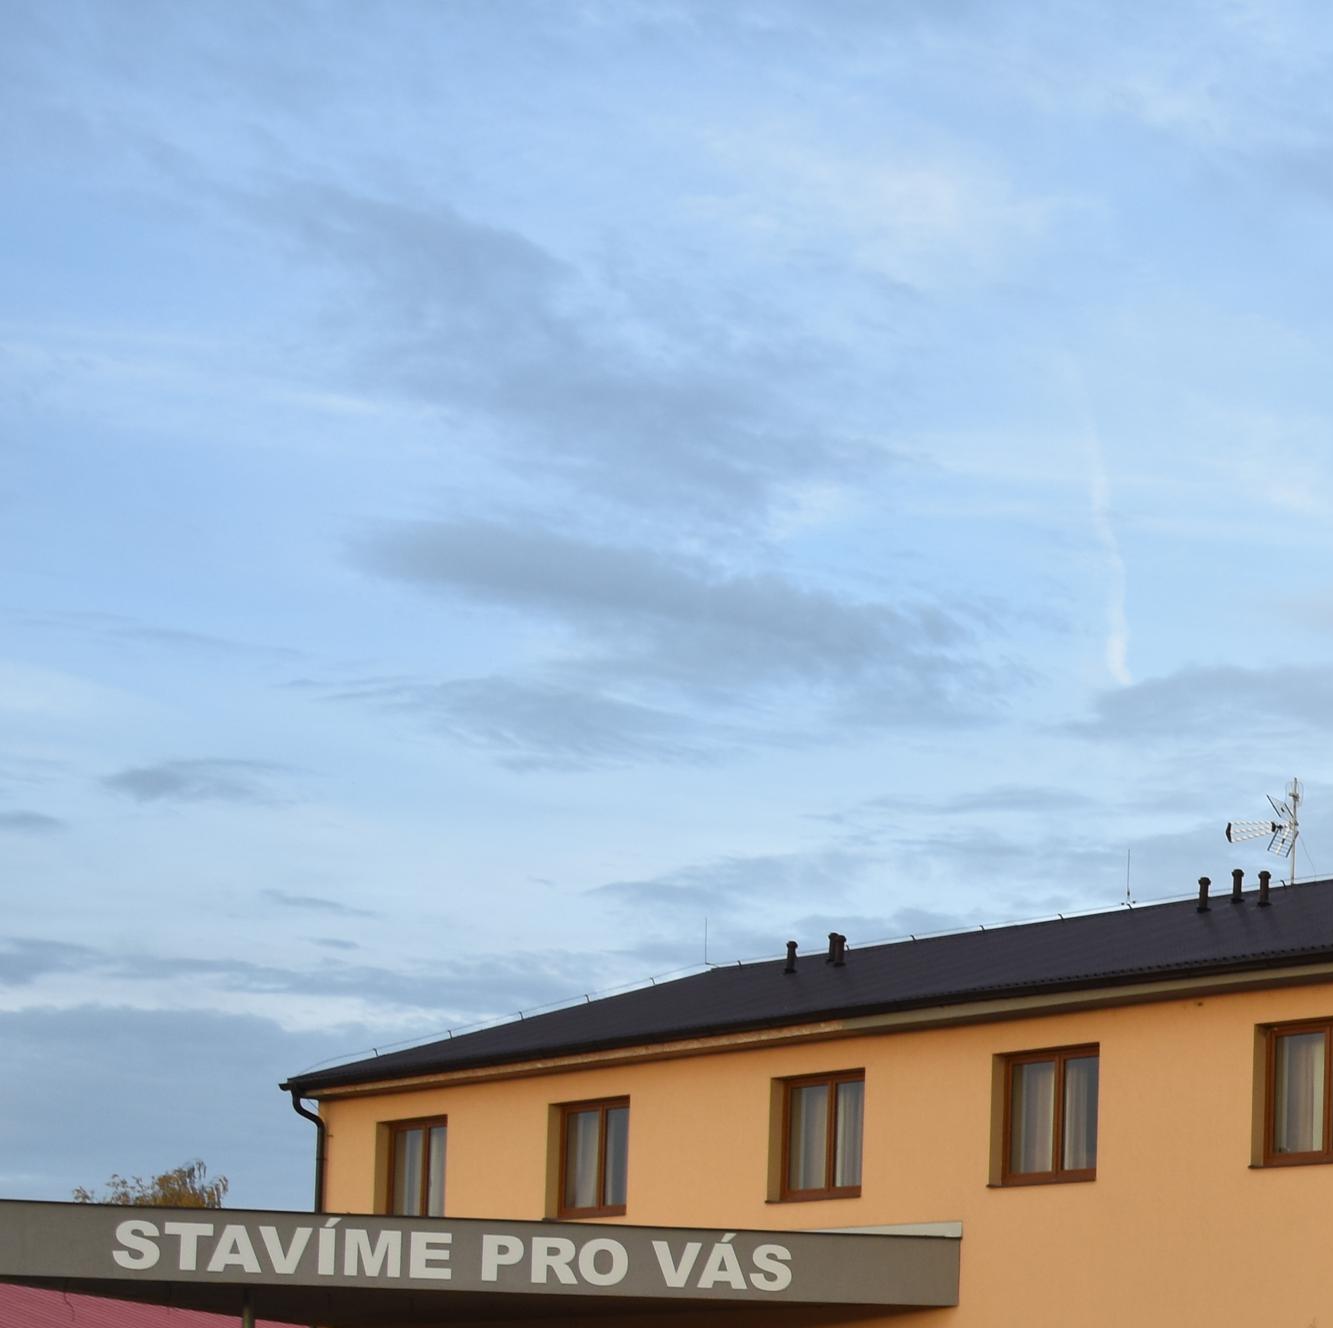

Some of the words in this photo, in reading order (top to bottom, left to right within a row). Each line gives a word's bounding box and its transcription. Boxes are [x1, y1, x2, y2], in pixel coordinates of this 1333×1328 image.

[112, 1218, 452, 1280] STAVÍME
[481, 1234, 629, 1287] PRO
[651, 1233, 793, 1292] VÁS
